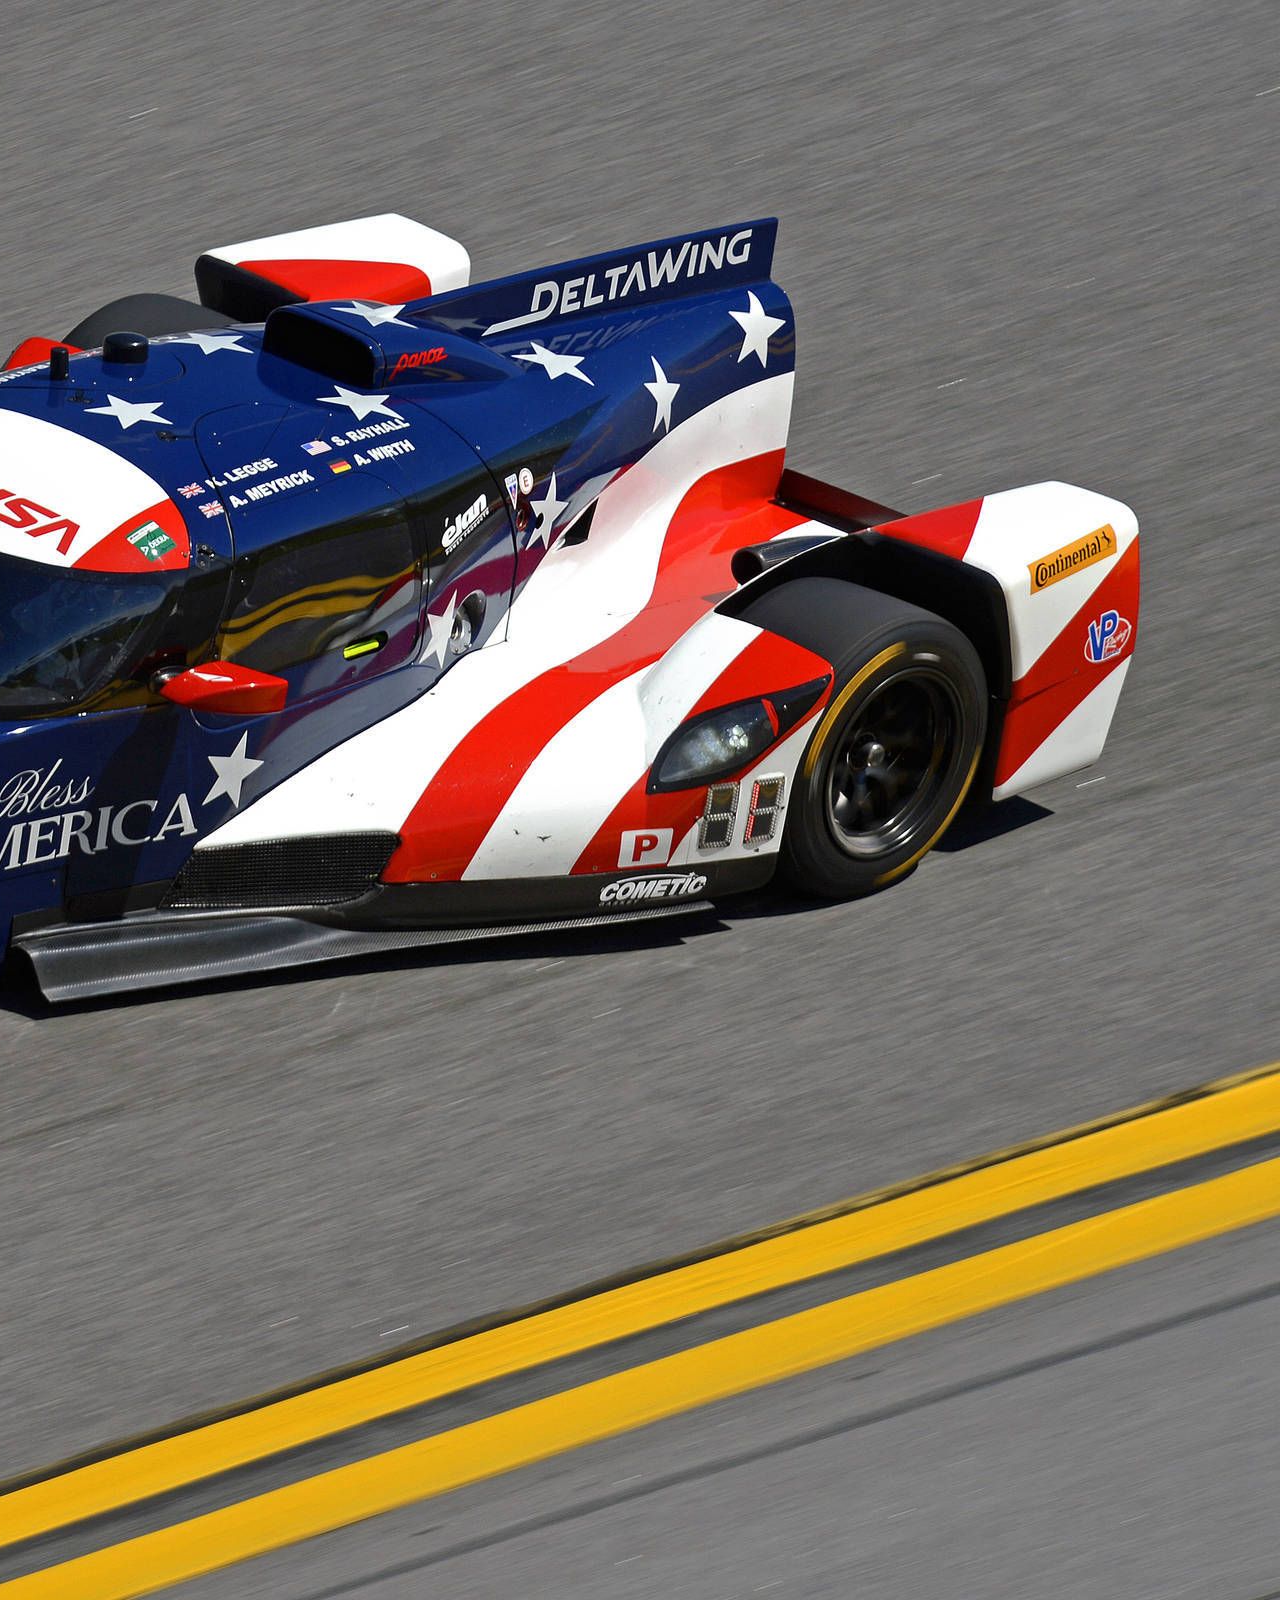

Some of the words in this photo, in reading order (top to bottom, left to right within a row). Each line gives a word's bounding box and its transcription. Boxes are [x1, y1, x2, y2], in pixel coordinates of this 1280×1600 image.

[330, 436, 350, 447] S.
[346, 418, 410, 442] RAYHALL
[353, 453, 370, 467] A.
[366, 439, 415, 462] WIRTH
[205, 477, 227, 490] K.
[224, 457, 278, 483] LEGGE
[229, 495, 248, 508] A.
[245, 469, 315, 502] MEYRICK
[1035, 536, 1101, 587] Continental
[1087, 609, 1120, 662] VP
[632, 834, 659, 862] P
[599, 874, 708, 902] COMETIC
